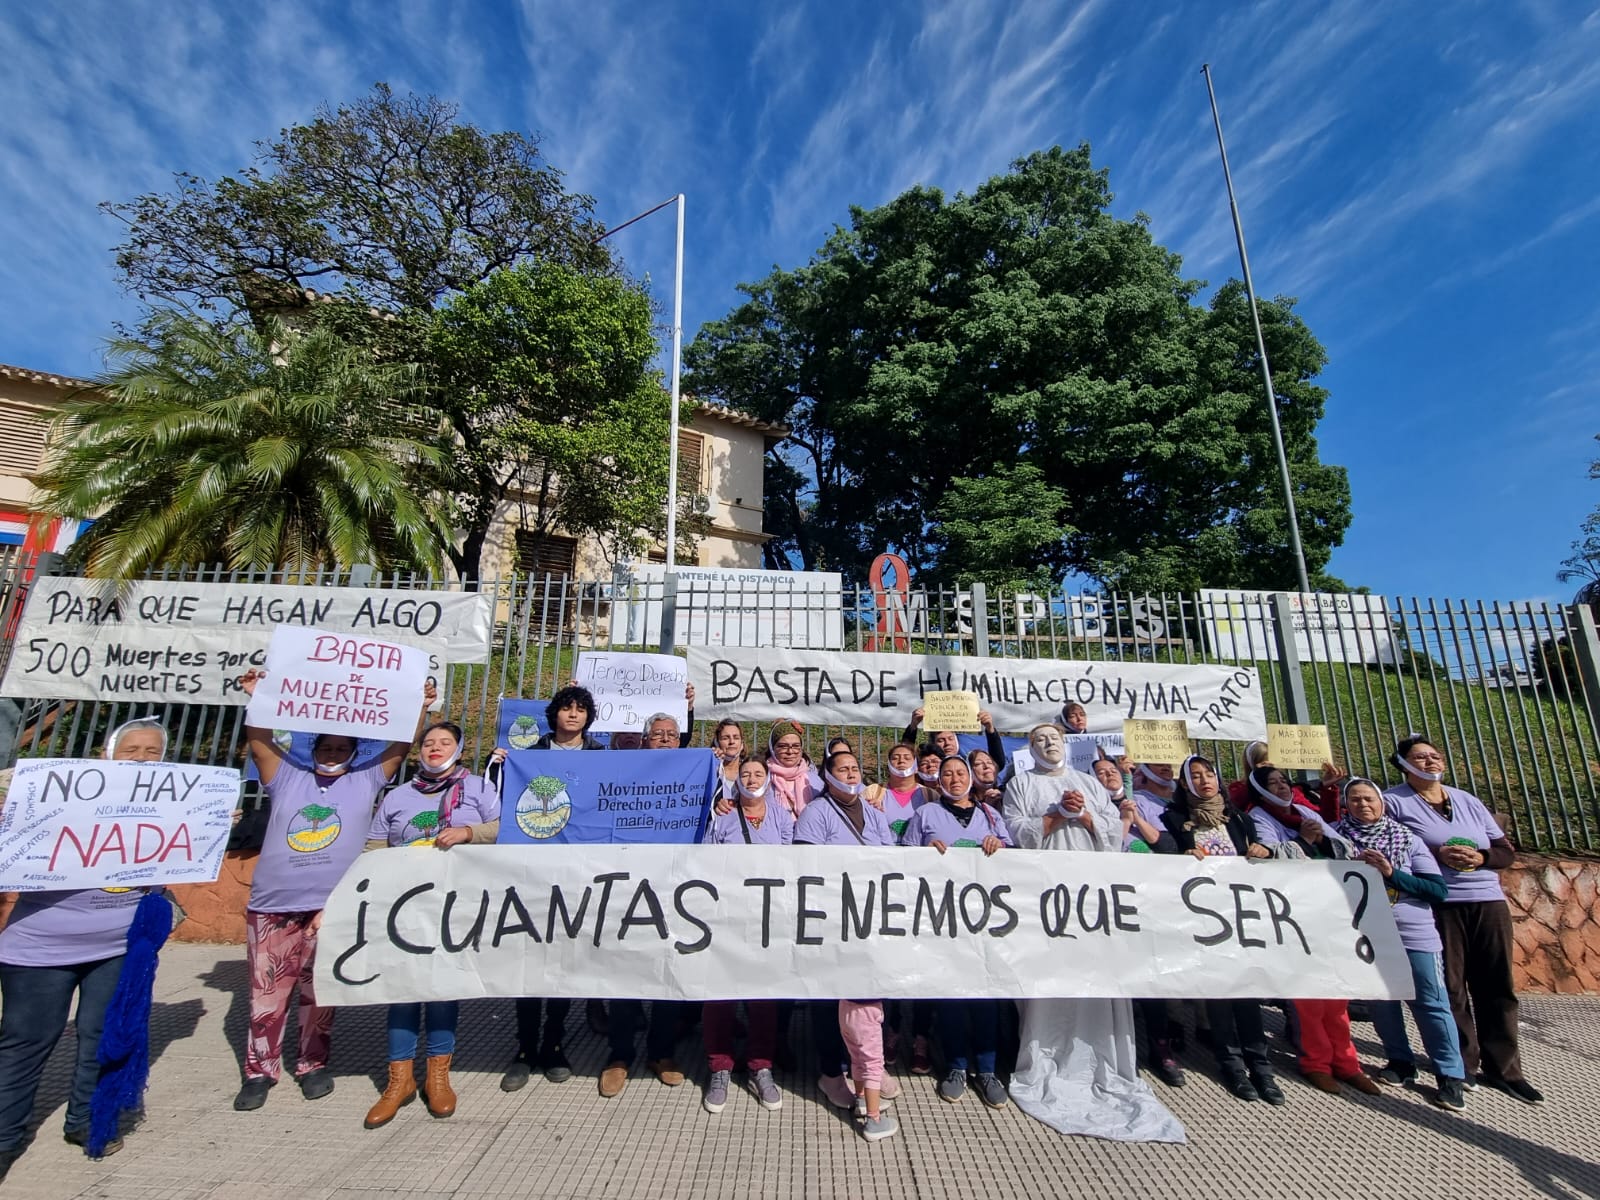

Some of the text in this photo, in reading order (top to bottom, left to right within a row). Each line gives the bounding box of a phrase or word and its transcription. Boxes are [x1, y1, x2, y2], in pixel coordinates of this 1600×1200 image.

[675, 569, 795, 584] ANTENÉ LA DISTANCIA
[47, 590, 442, 636] PARA QUE HAGAN ALGO
[25, 638, 92, 678] 500
[105, 643, 207, 671] Muertes
[307, 635, 402, 671] BASTA
[349, 673, 364, 683] DE
[585, 657, 636, 685] Tengo
[280, 677, 388, 708] MUERTES
[710, 659, 841, 706] BASTA
[851, 669, 898, 707] DE
[1143, 681, 1199, 714] MAL
[276, 699, 389, 726] MATERNAS
[40, 768, 201, 803] NO HAY
[597, 781, 685, 796] Movimiento
[94, 805, 113, 815] NO
[130, 806, 157, 814] NADA
[597, 797, 651, 811] Derecho
[655, 801, 662, 809] a
[666, 796, 676, 808] la
[615, 814, 701, 830] maría rivarola
[48, 822, 193, 872] NADA
[744, 871, 1019, 948] TENEMOS
[1039, 882, 1141, 939] QUE
